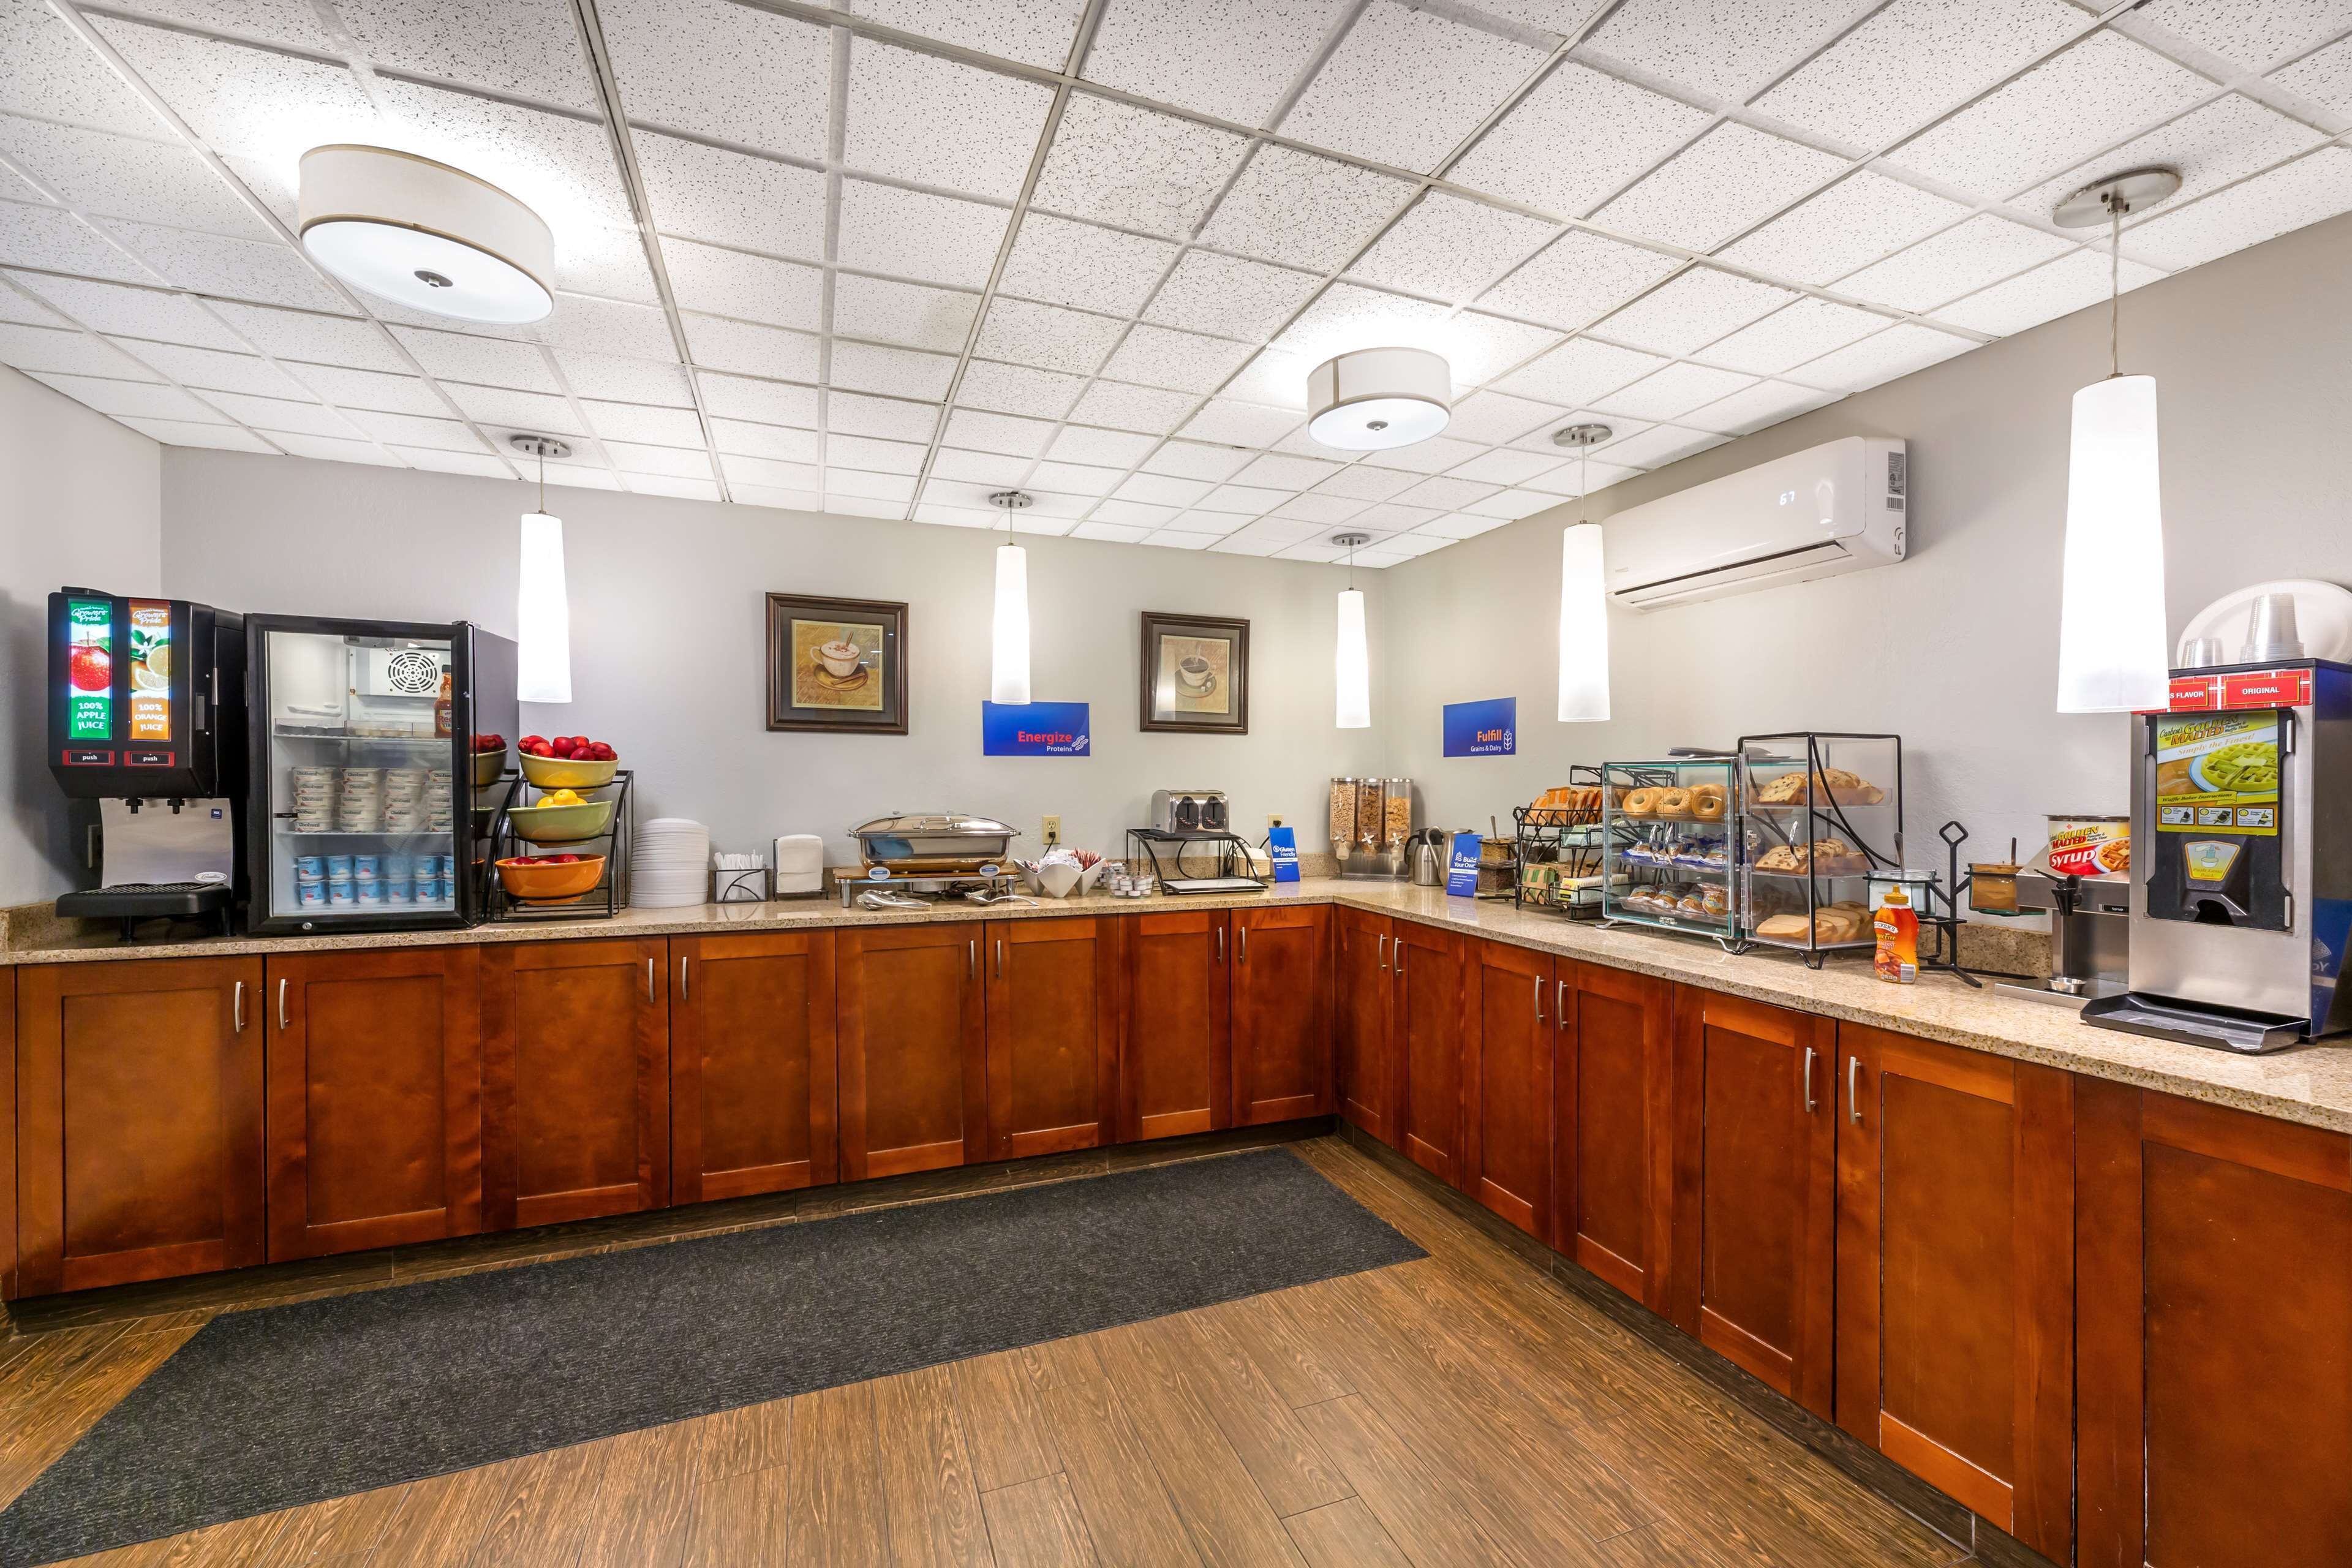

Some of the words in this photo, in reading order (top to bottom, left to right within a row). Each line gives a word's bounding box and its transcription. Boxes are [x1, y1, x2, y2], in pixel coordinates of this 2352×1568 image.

[1780, 491, 1795, 505] 67
[2242, 687, 2280, 695] ORIGINAL
[77, 711, 106, 720] APPLE
[78, 721, 105, 730] JUICE
[140, 723, 163, 732] JUICE
[2184, 714, 2239, 734] GOLDEN
[1018, 731, 1072, 745] Energize
[1477, 729, 1502, 742] Fulfill
[2160, 726, 2183, 738] Carbon's
[2170, 725, 2225, 746] MALTED
[2058, 826, 2099, 840] GOLDEN
[2052, 836, 2087, 850] MALTED
[2051, 850, 2096, 867] Syrup
